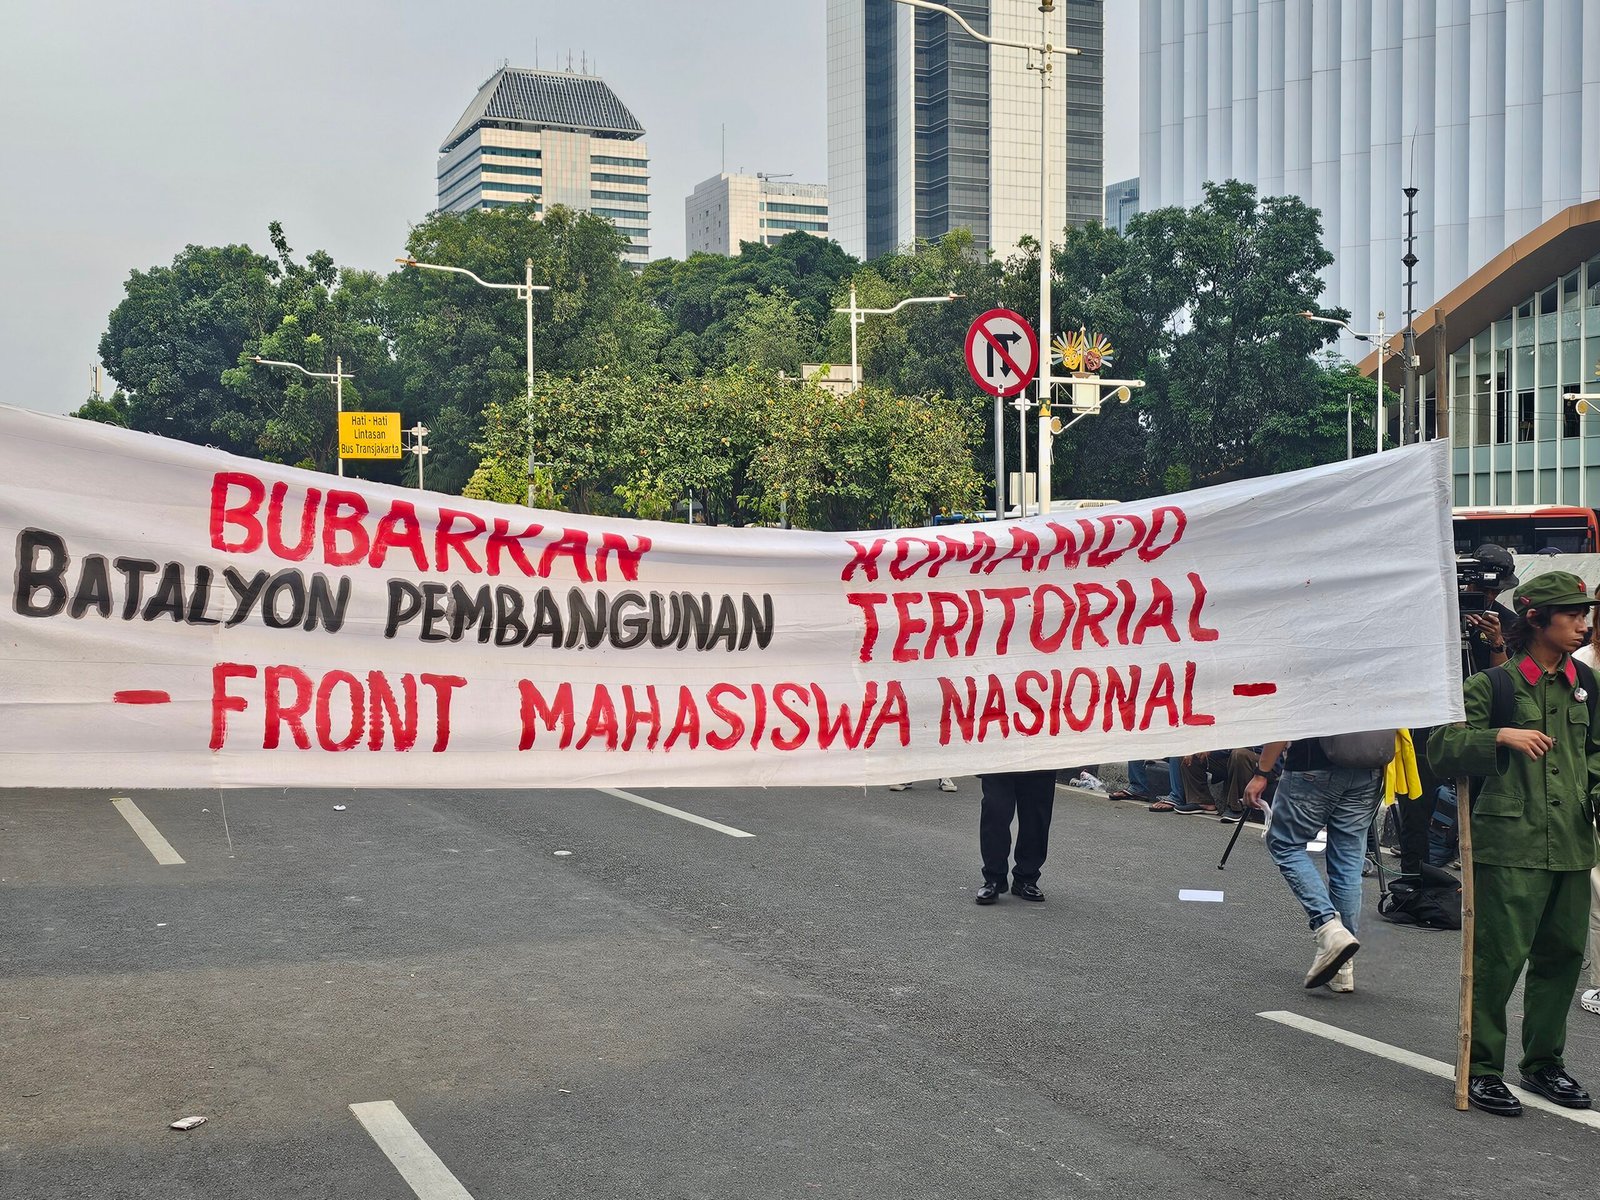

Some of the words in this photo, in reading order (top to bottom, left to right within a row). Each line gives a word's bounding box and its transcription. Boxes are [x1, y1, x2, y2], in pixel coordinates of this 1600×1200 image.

[341, 443, 354, 454] Bus
[356, 442, 399, 456] Transjakarta
[351, 415, 367, 426] Hati
[372, 415, 388, 426] Hati
[354, 429, 386, 440] Lintasan
[209, 471, 653, 584] BUBARKAN
[841, 506, 1187, 583] KOMANDO
[14, 527, 351, 634] BATALYON
[384, 577, 776, 652] PEMBANGUNAN
[847, 572, 1220, 664] TERITORIAL
[209, 663, 468, 752] FRONT
[518, 680, 911, 752] MAHASISWA
[940, 662, 1216, 746] NASIONAL
